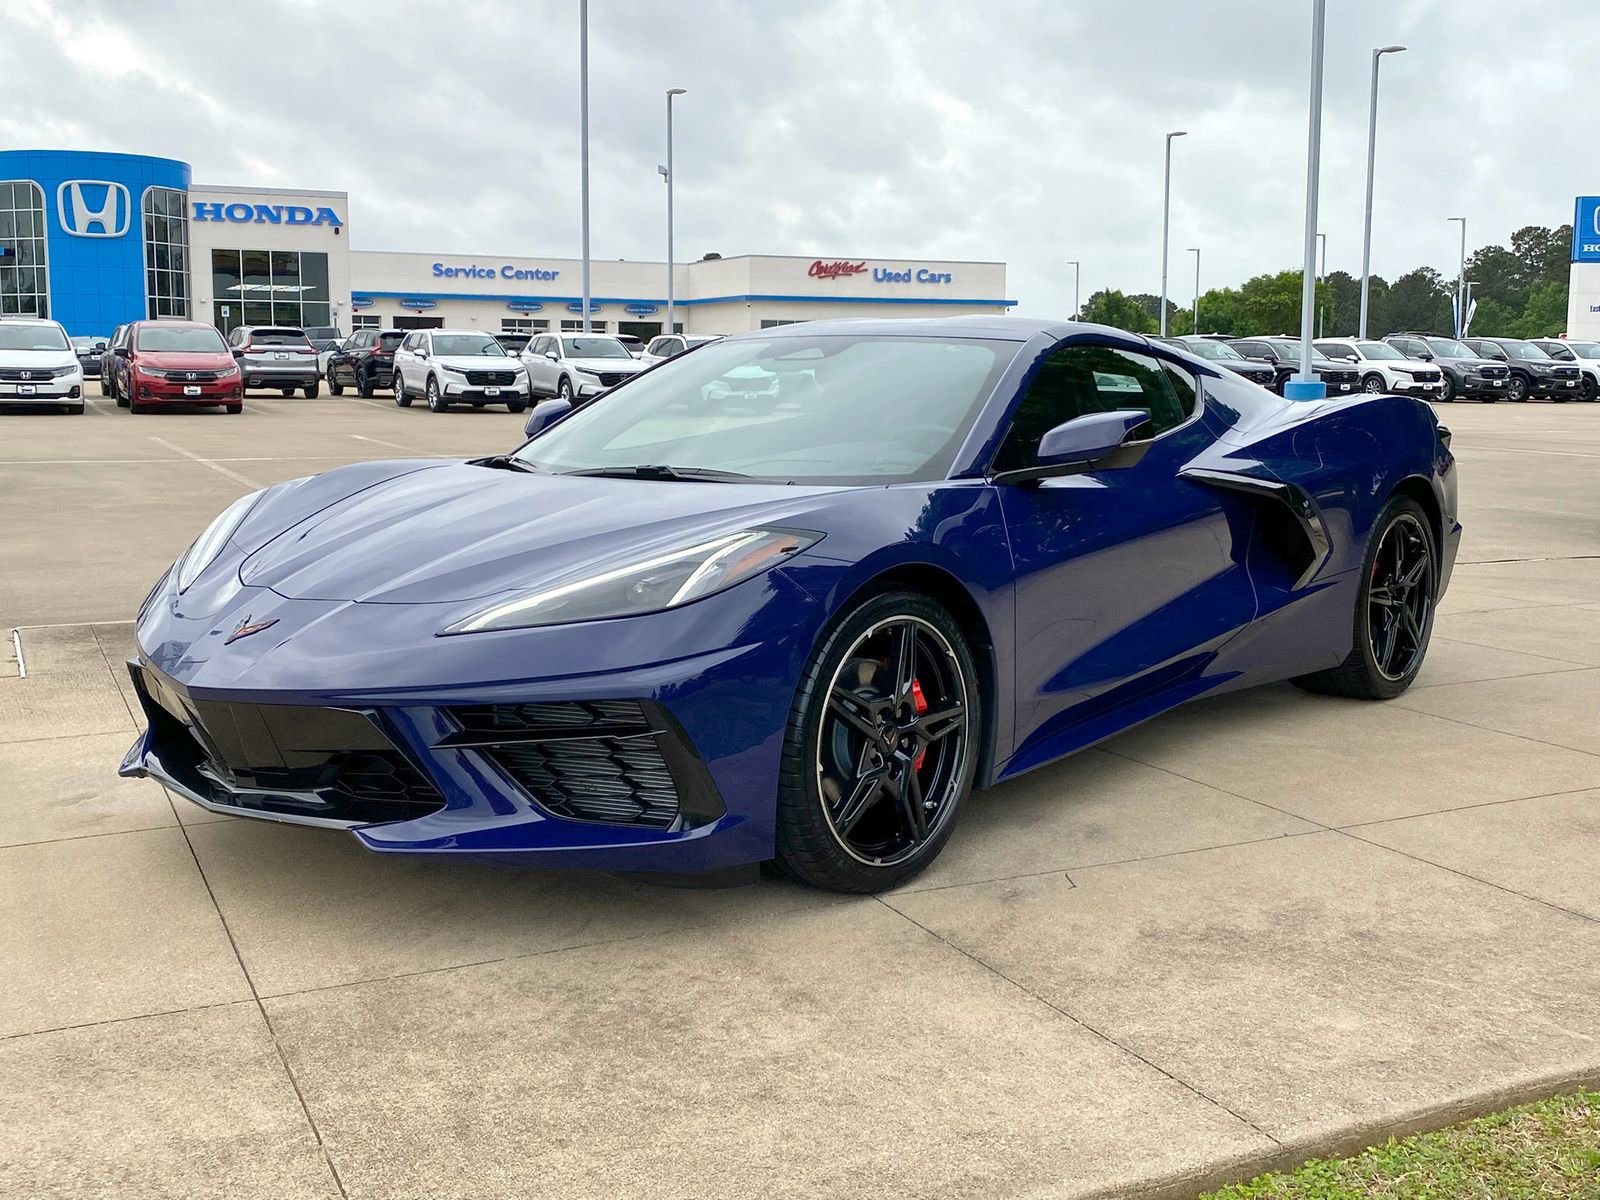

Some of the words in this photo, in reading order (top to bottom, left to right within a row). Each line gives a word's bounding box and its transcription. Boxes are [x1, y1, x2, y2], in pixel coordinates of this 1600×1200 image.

[192, 202, 343, 227] HONDA
[432, 262, 496, 279] Service
[500, 265, 560, 281] Center
[873, 268, 912, 283] Used
[916, 269, 952, 283] Cars
